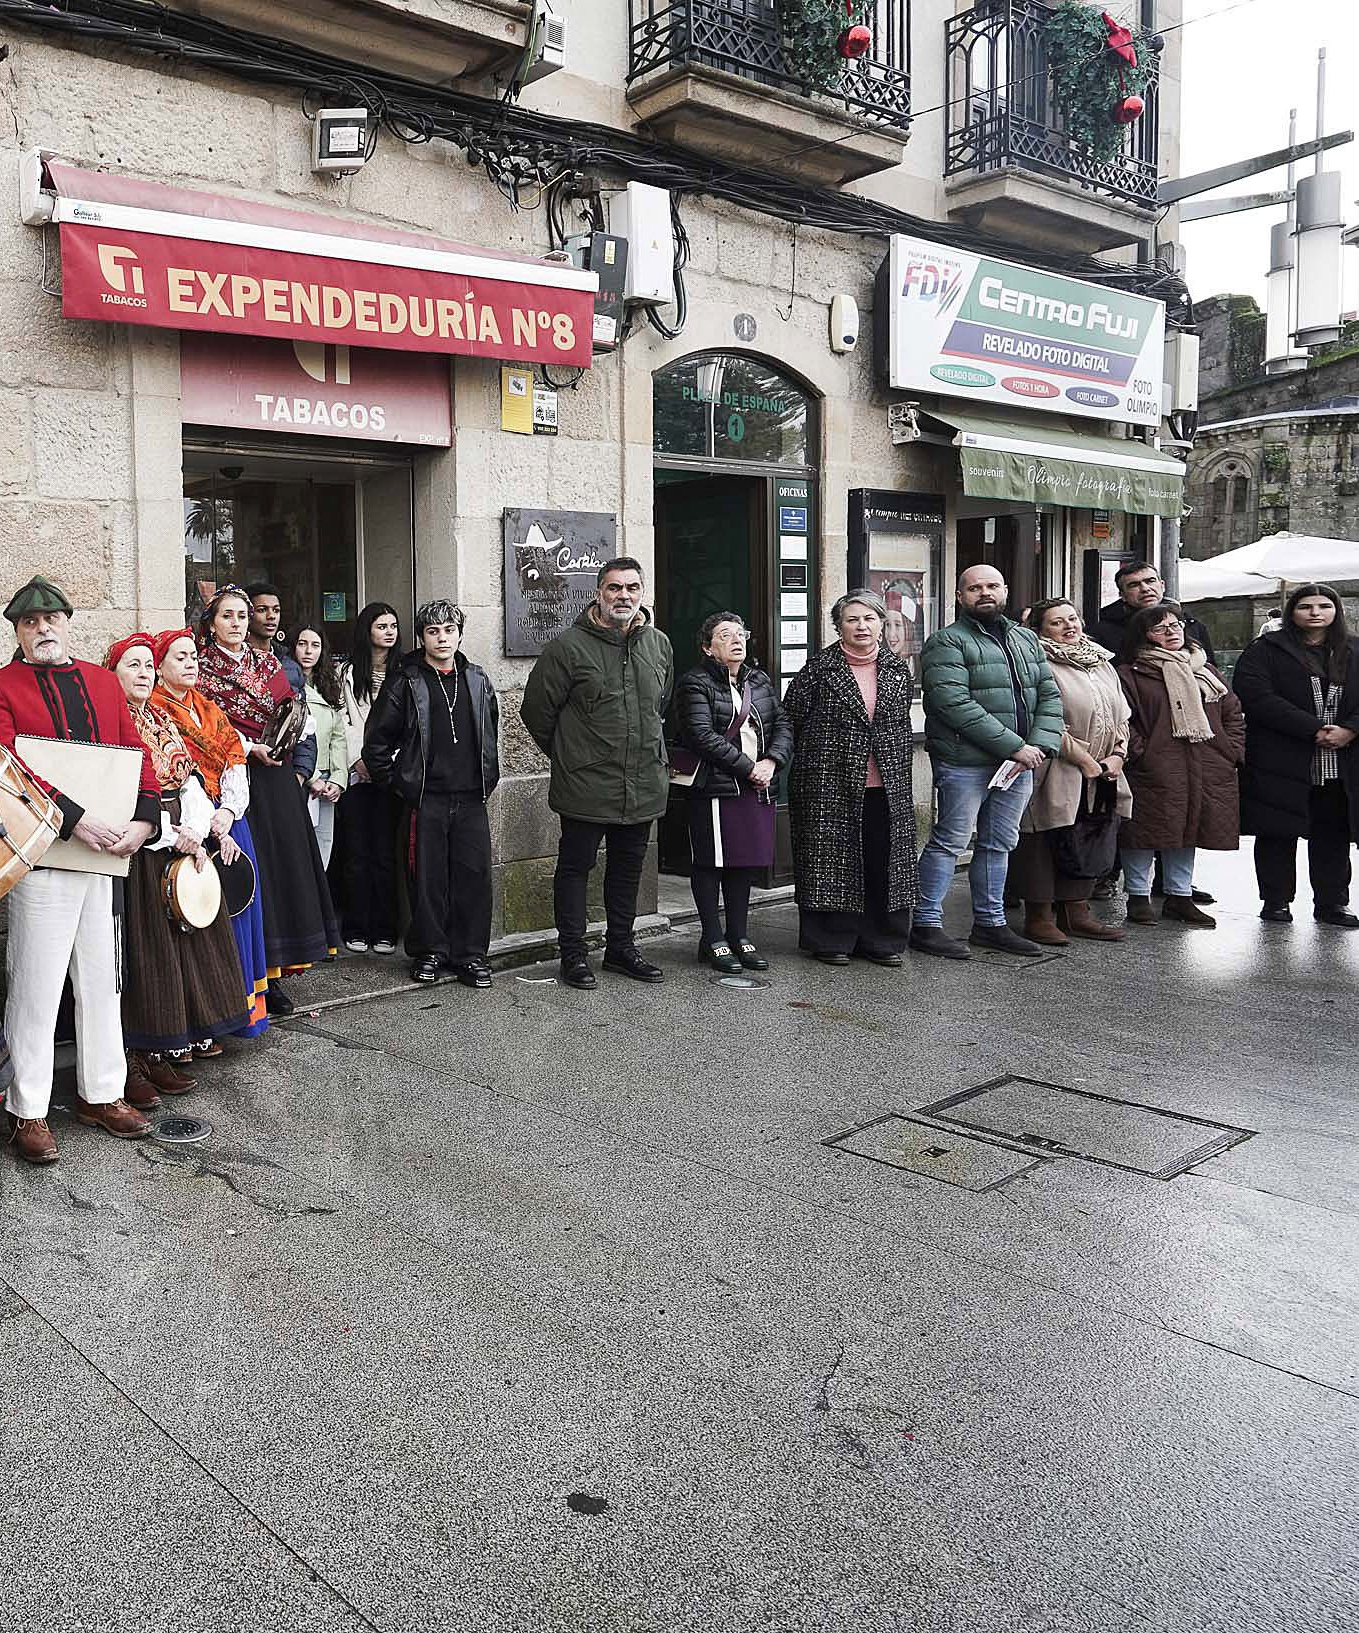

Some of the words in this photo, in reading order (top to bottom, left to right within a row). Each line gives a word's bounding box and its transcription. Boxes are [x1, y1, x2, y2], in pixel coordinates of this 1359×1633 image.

[100, 293, 148, 308] TABACOS
[166, 267, 503, 345] EXPENDEDURÍA
[978, 276, 1084, 327] CENTRO
[1086, 302, 1139, 340] FUJI
[982, 333, 1042, 360] REVELADO
[1042, 342, 1072, 367] FOTO
[1072, 348, 1111, 374] DIGITAL
[936, 367, 967, 382] REVELADO
[966, 372, 989, 385] DIGITAL
[1011, 379, 1030, 392] FOTOS
[1133, 379, 1153, 396] FOTO
[724, 392, 739, 406] DE
[1076, 391, 1090, 402] FOTO
[254, 394, 386, 431] TABACOS
[1126, 399, 1158, 417] OLIMPIO
[1026, 464, 1071, 493] Olimpio
[779, 487, 808, 498] OFICINAS
